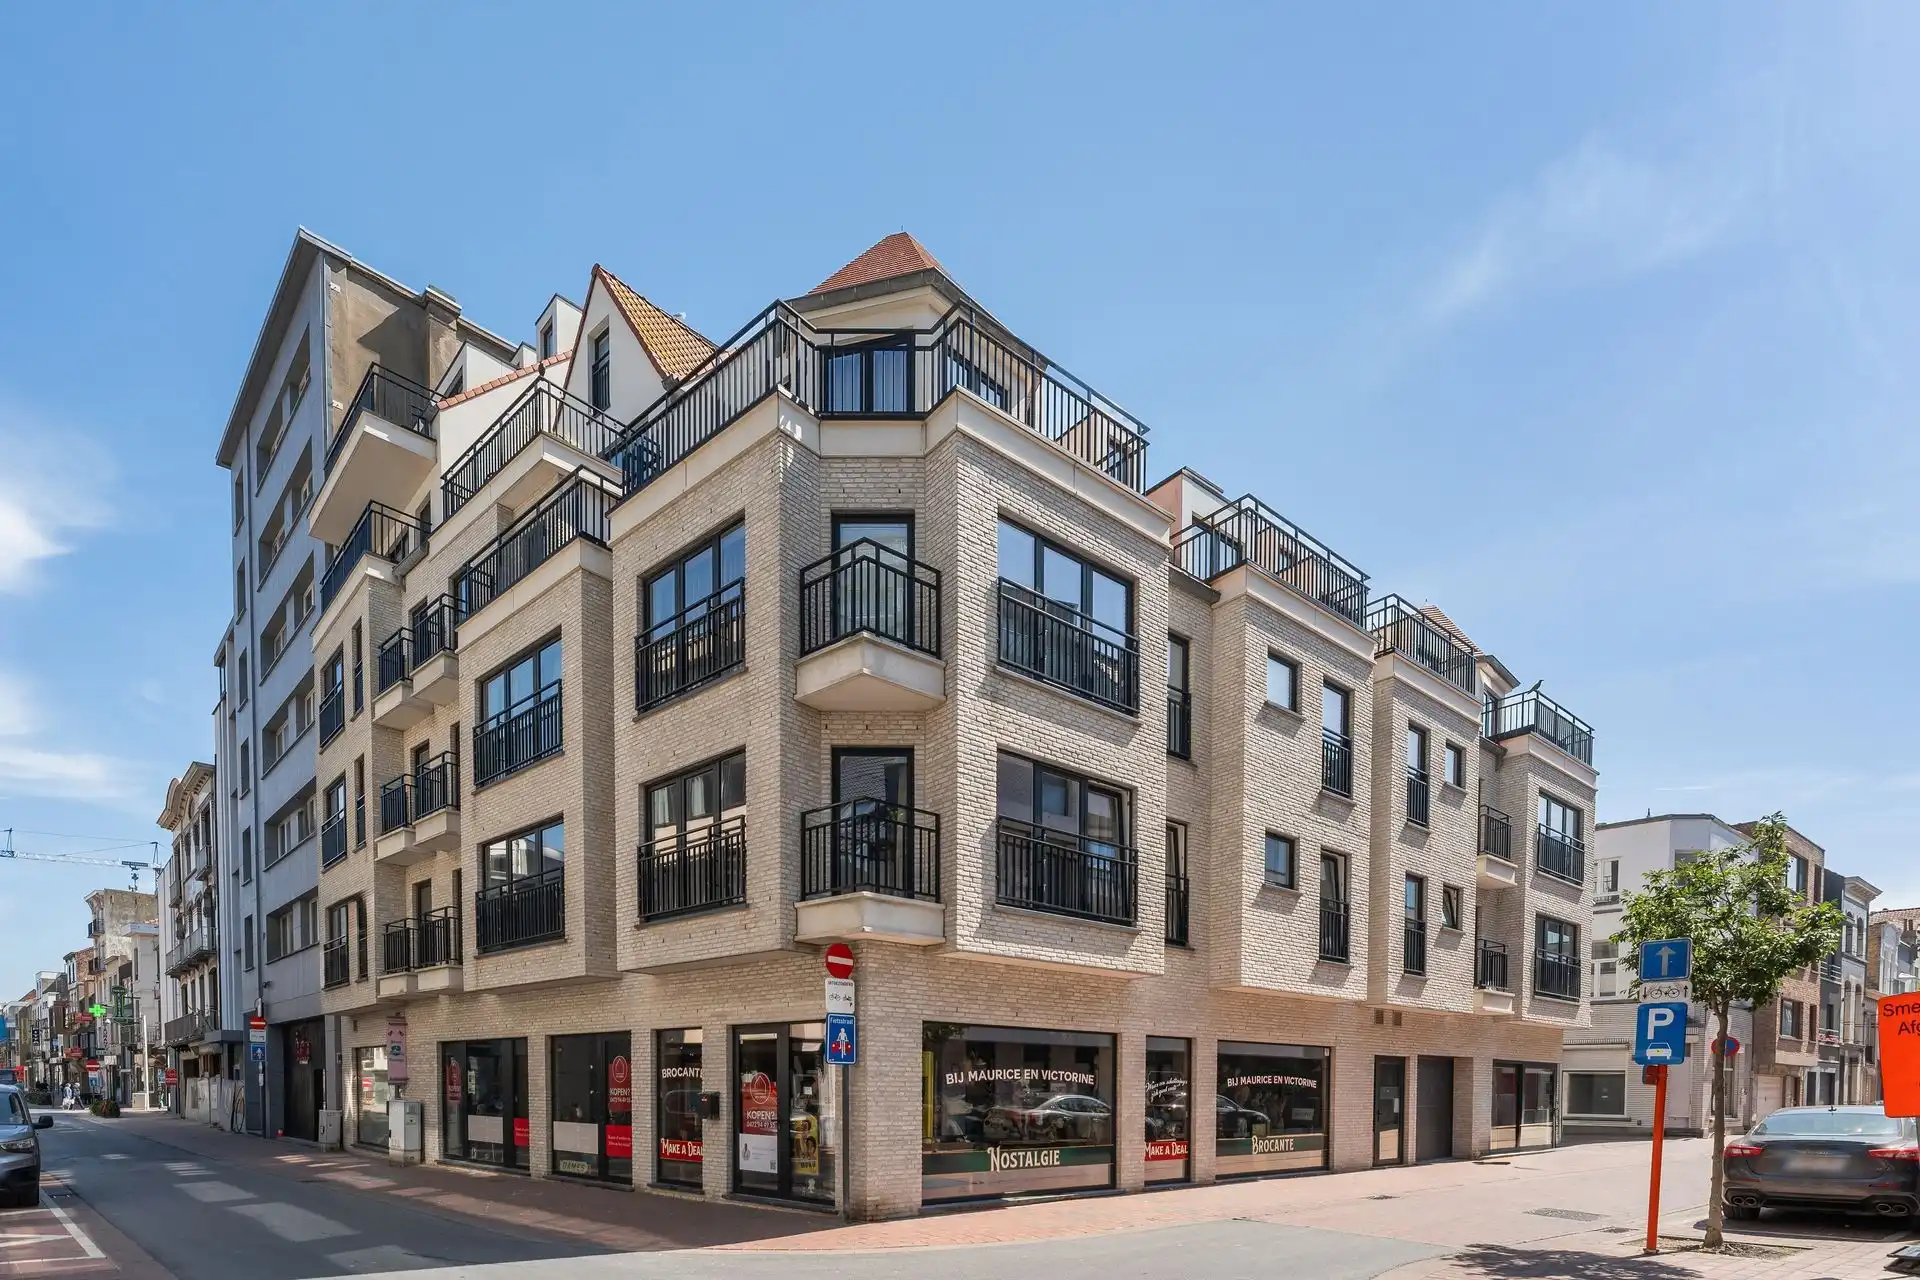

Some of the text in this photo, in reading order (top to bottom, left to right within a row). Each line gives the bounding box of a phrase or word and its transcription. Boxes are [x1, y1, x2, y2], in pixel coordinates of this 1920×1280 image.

[1647, 1008, 1674, 1040] P
[945, 1069, 1095, 1085] BIJ MAURICE EN VICTORINE
[1227, 1075, 1317, 1088] BIJ MAURICE EN VICTORINE
[746, 1110, 775, 1120] KOPEN?
[1252, 1135, 1294, 1155] BROCANTE
[987, 1146, 1060, 1173] NOSTALGIE
